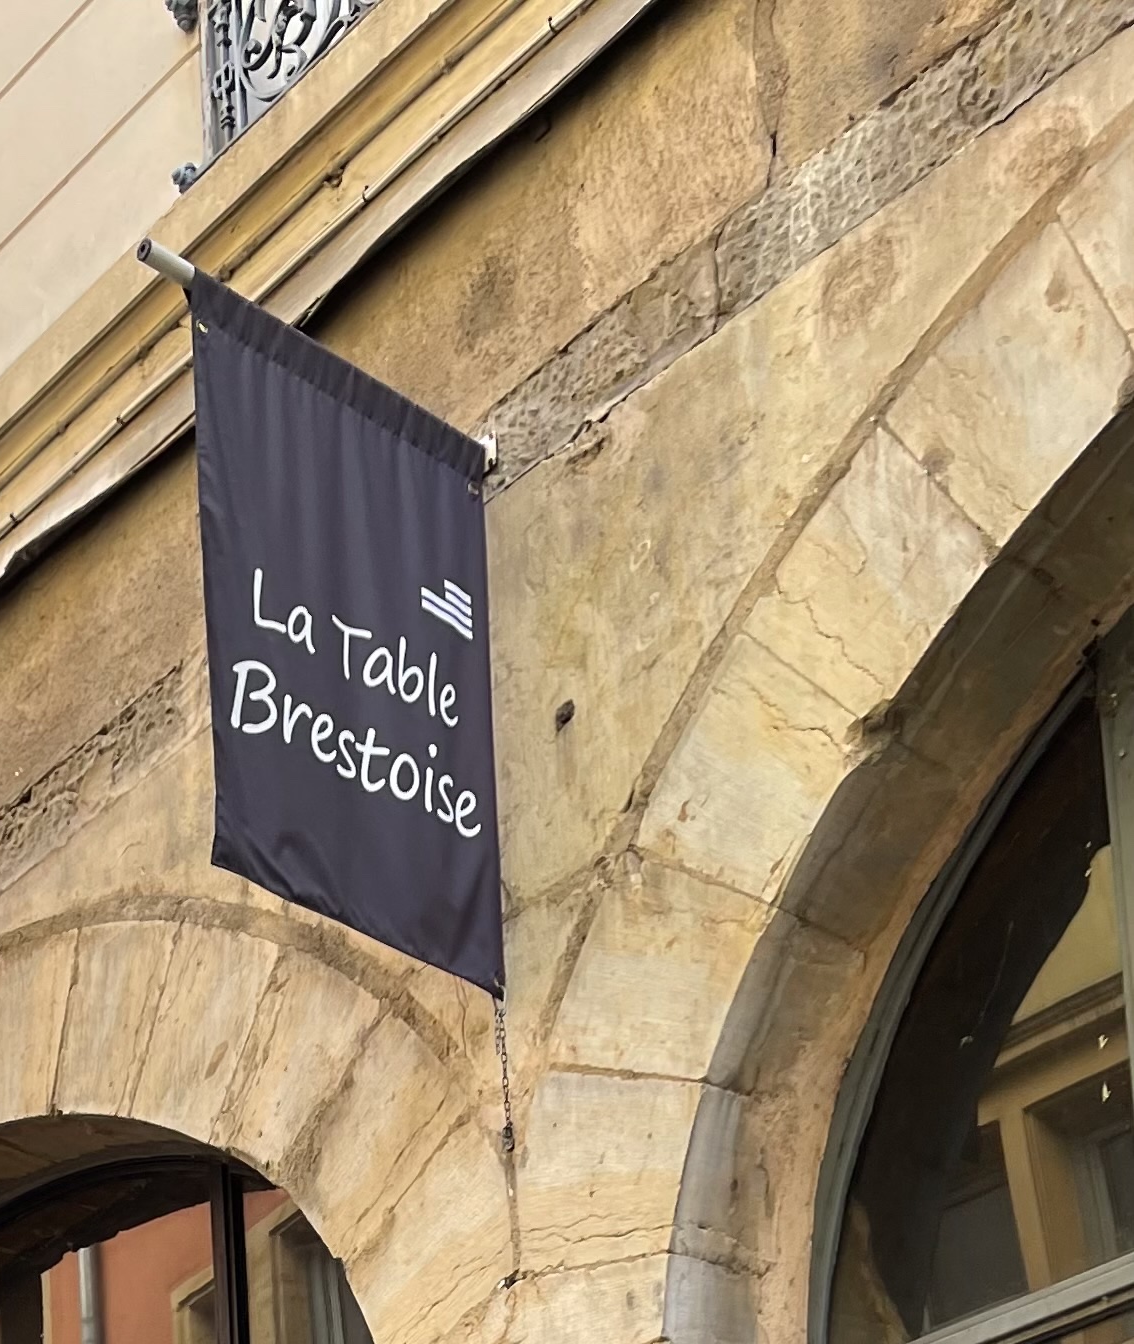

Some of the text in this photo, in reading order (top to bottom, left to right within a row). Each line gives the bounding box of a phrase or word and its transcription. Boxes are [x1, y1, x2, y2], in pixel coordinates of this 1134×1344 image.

[252, 567, 459, 728] La Table
[229, 659, 483, 837] Brestoise
